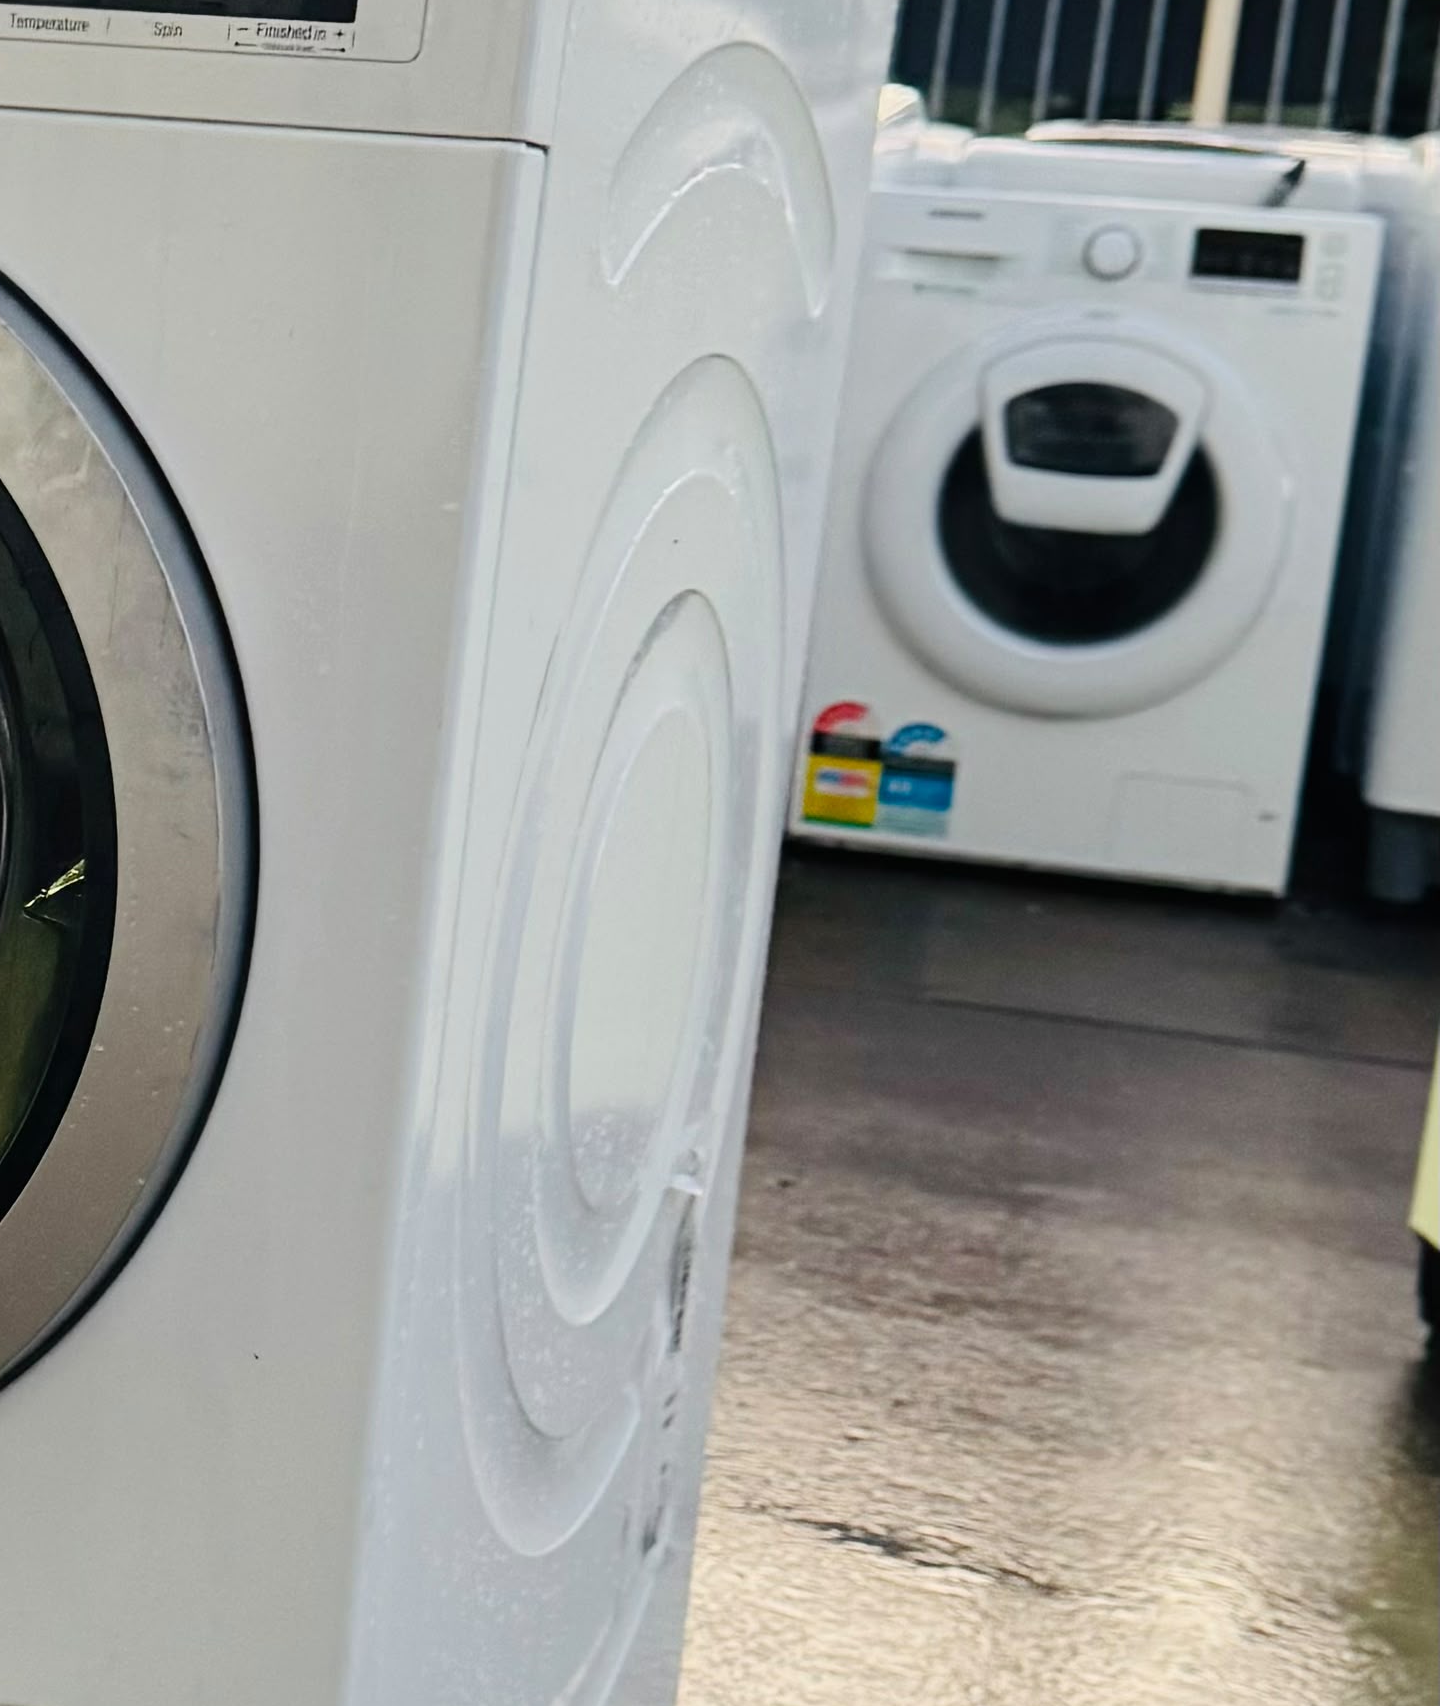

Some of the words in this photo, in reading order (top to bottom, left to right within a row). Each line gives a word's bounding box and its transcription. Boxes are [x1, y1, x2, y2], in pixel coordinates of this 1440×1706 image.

[10, 12, 90, 33] Temperature
[153, 21, 183, 38] Spin
[256, 22, 312, 41] Finished
